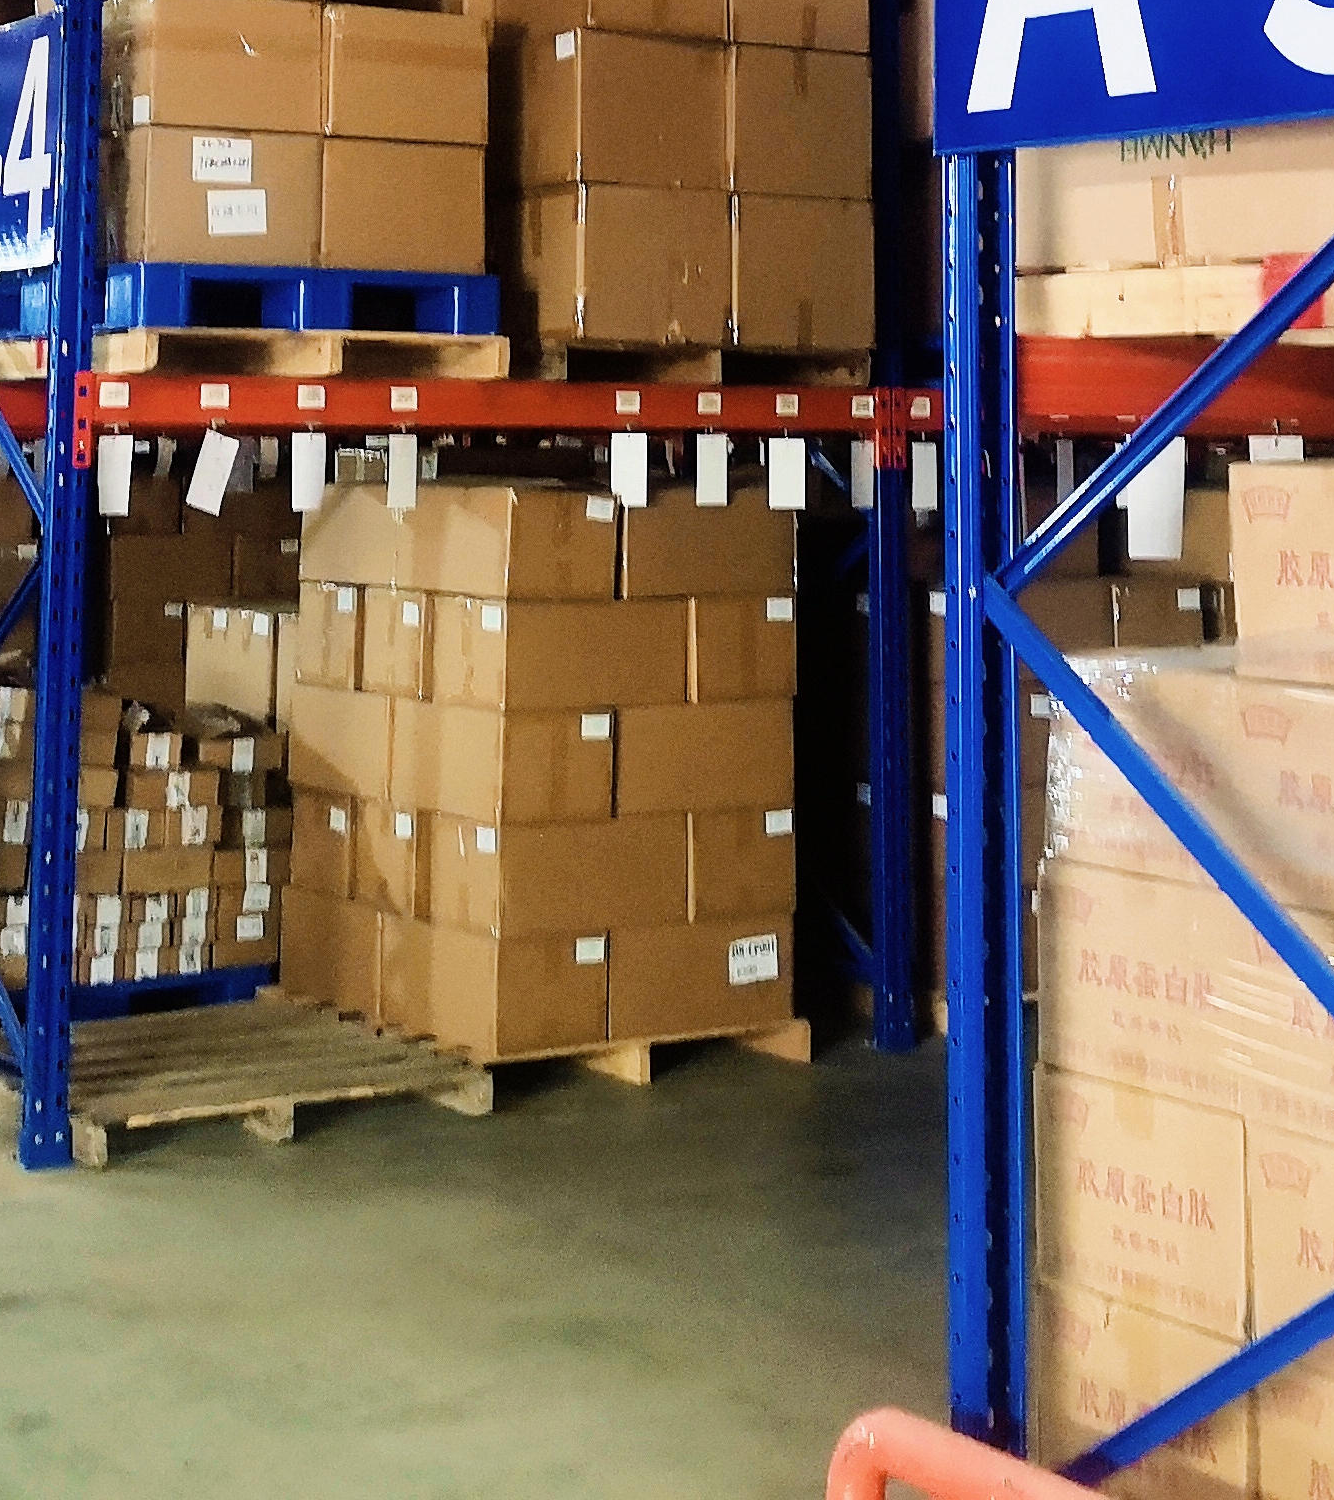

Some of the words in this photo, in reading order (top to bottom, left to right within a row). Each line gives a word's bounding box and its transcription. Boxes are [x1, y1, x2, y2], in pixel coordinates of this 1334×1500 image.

[1077, 948, 1218, 1013] 胶原蛋白肽
[1077, 1159, 1218, 1233] 胶原蛋白肽
